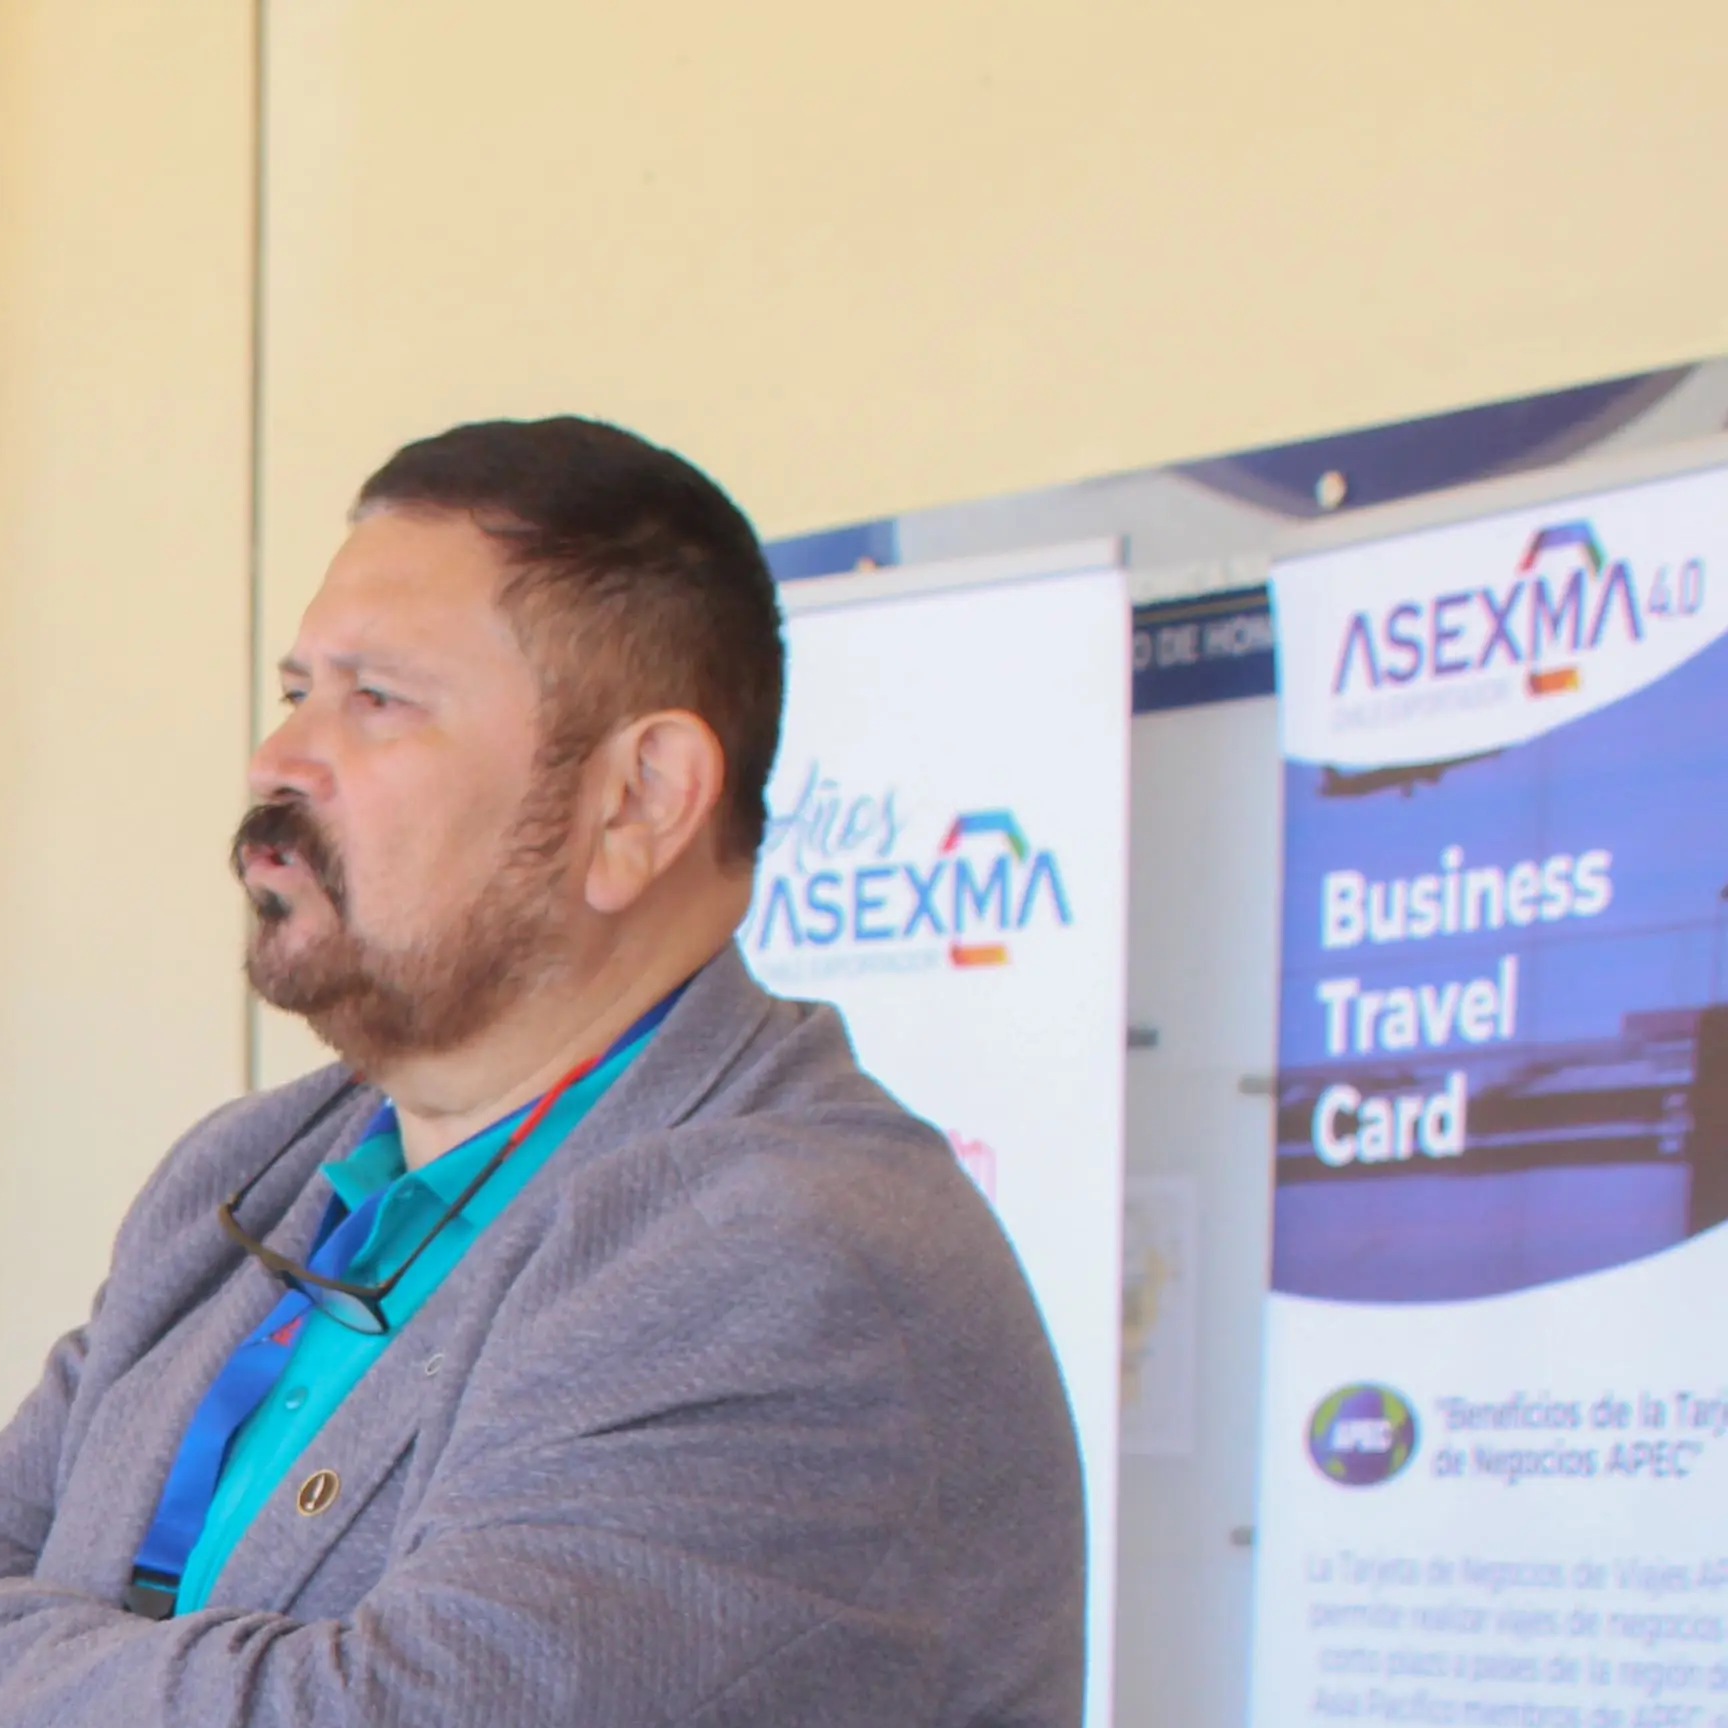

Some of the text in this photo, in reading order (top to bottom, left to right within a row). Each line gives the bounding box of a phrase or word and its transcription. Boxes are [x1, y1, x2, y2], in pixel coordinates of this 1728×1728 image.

[1333, 559, 1645, 695] ASEXMA
[758, 848, 1073, 952] ASEXMA
[1320, 844, 1614, 950] Business
[1316, 953, 1520, 1057] Travel
[1311, 1070, 1469, 1168] Card
